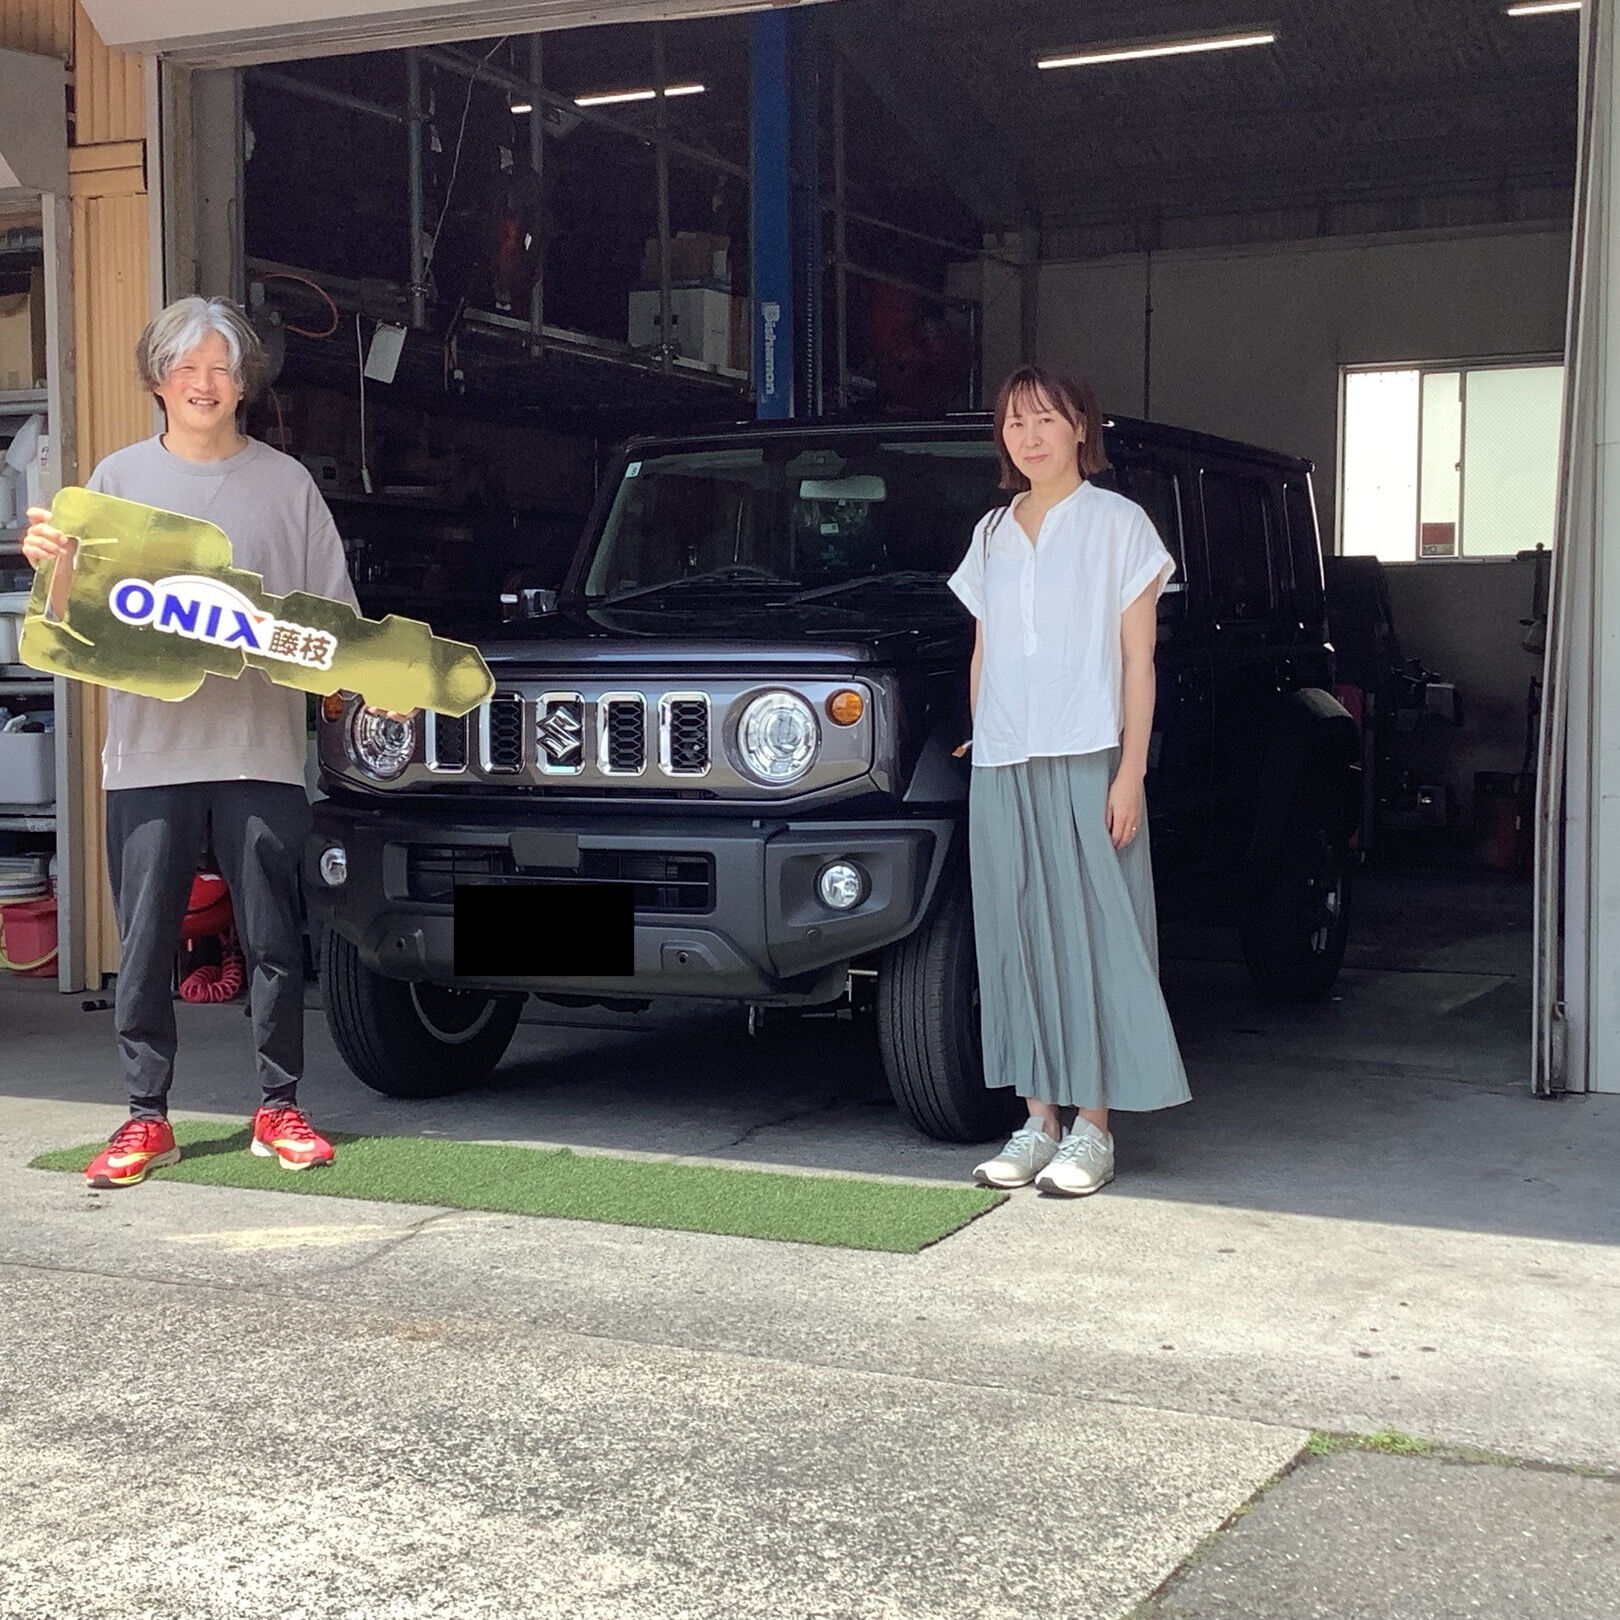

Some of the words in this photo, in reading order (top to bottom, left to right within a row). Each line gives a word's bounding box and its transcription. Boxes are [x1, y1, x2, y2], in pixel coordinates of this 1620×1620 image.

[761, 302, 780, 395] Bishamon
[115, 584, 261, 650] ONIX
[268, 625, 332, 666] 藤枝
